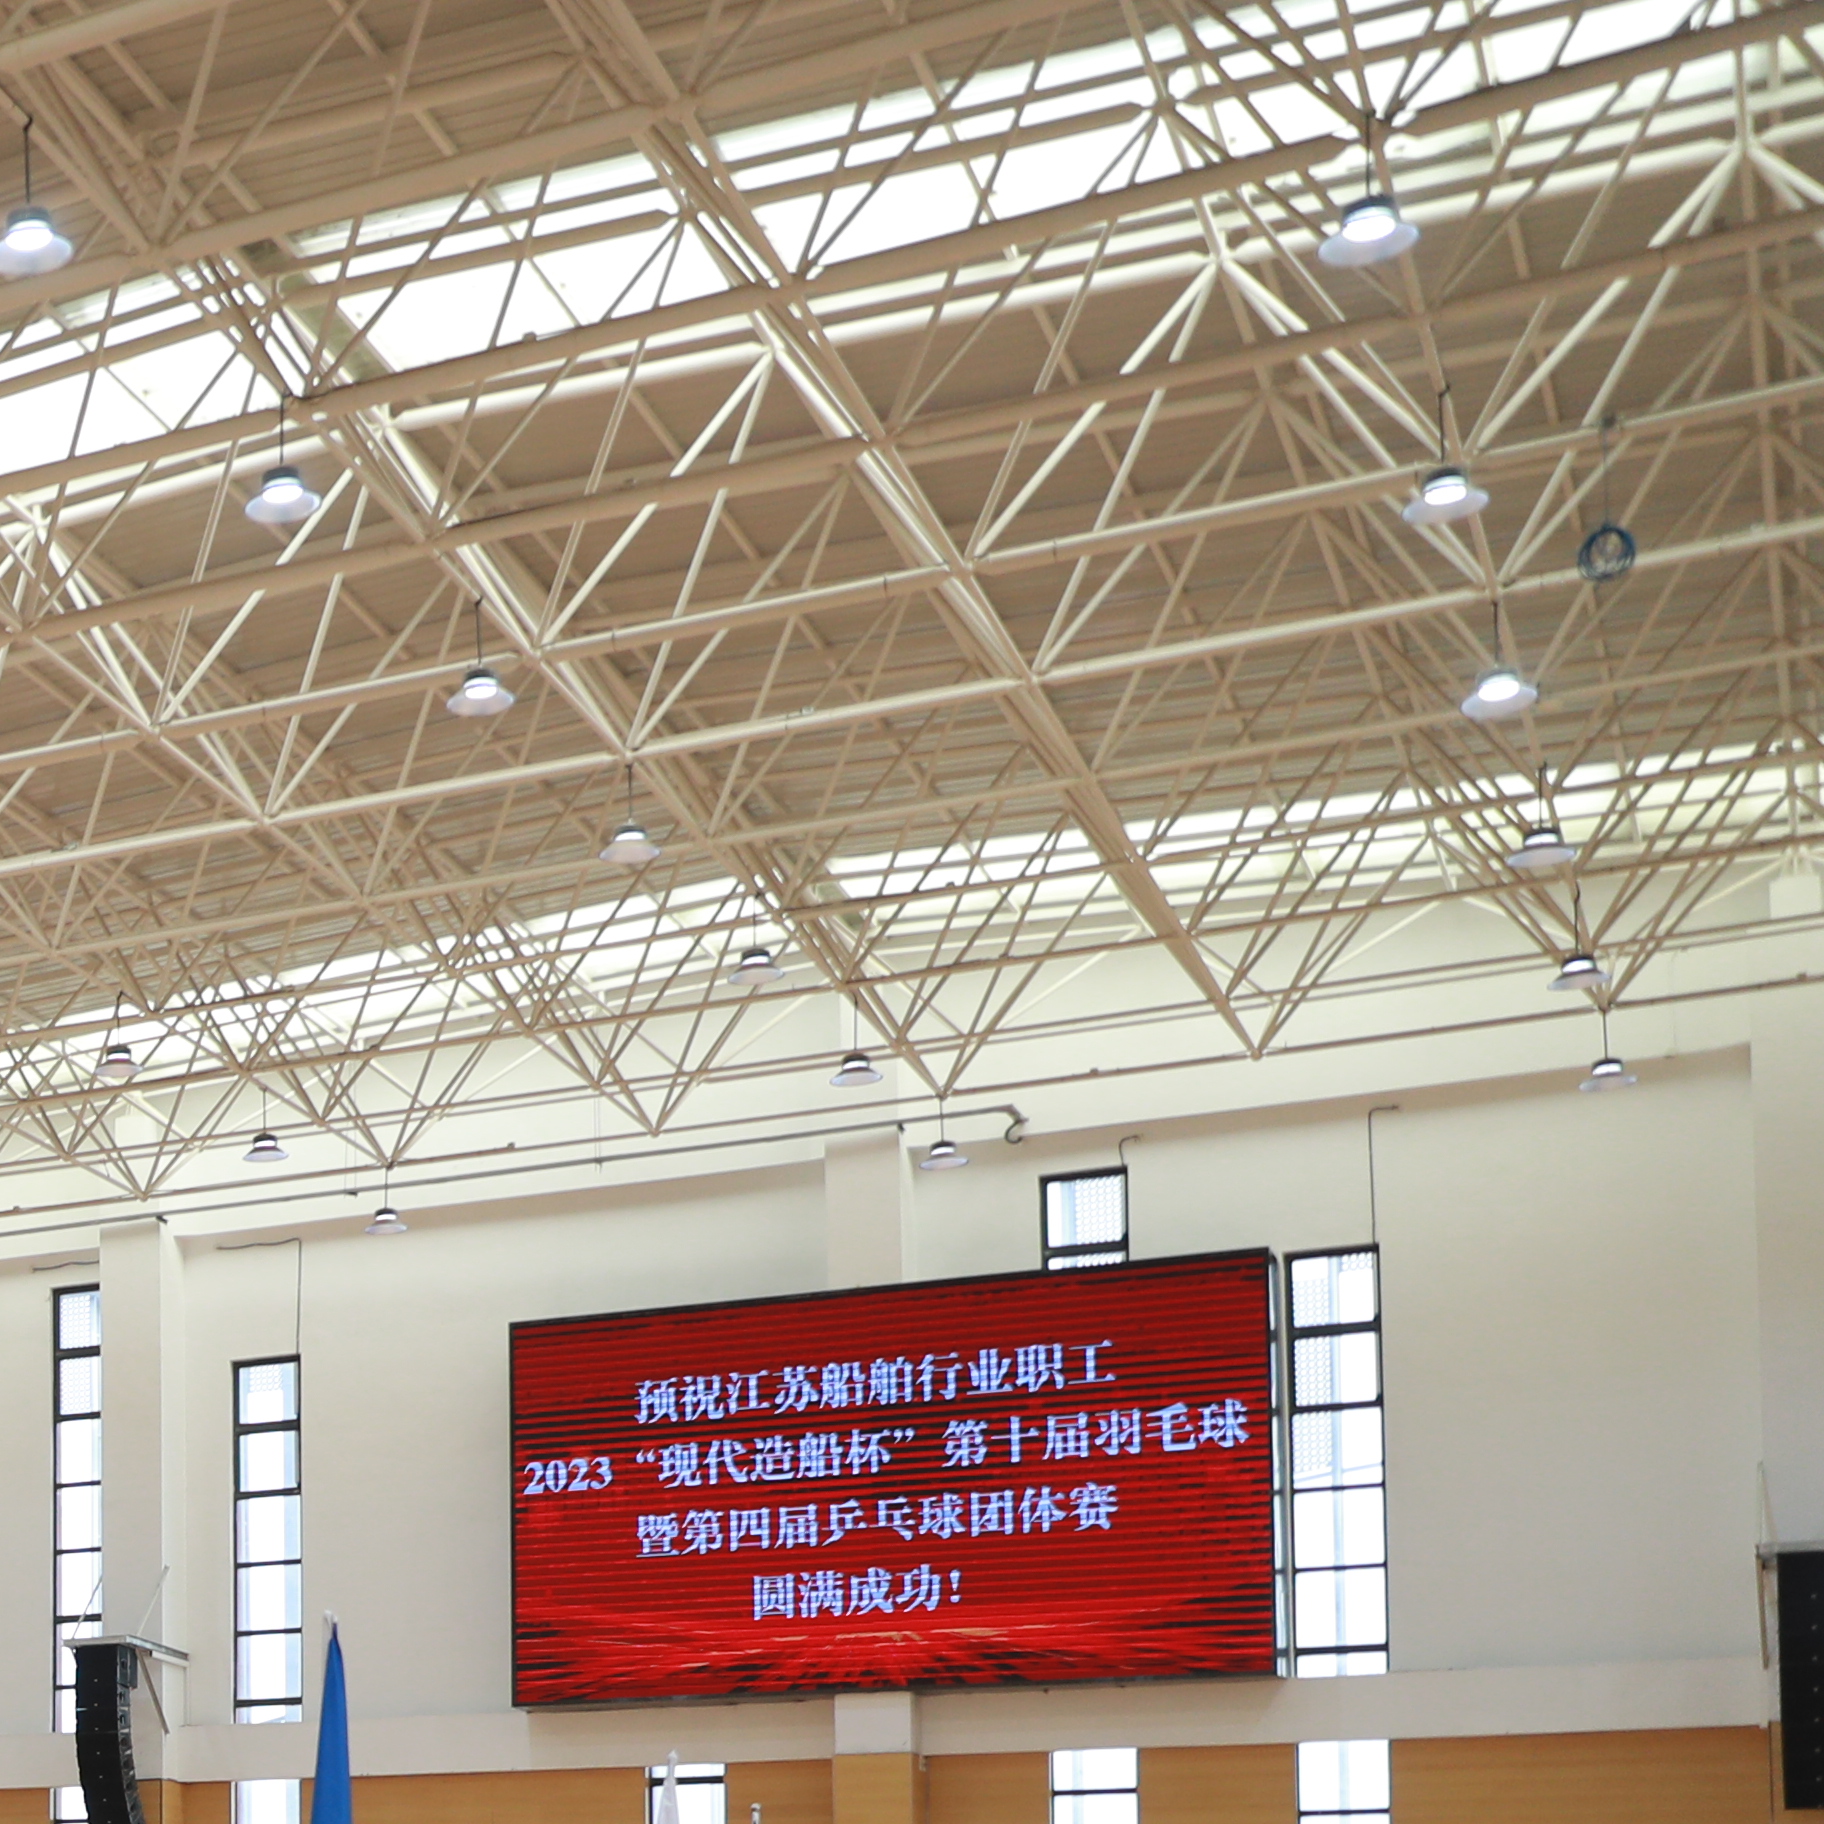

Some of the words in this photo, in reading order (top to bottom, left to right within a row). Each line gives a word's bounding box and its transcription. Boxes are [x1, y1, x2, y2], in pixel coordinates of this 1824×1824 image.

[635, 1339, 1115, 1425] 预祝江苏船舶行业职工
[636, 1482, 1119, 1559] 暨第四届乒乓球团体赛
[752, 1565, 962, 1621] 圆满成功!
